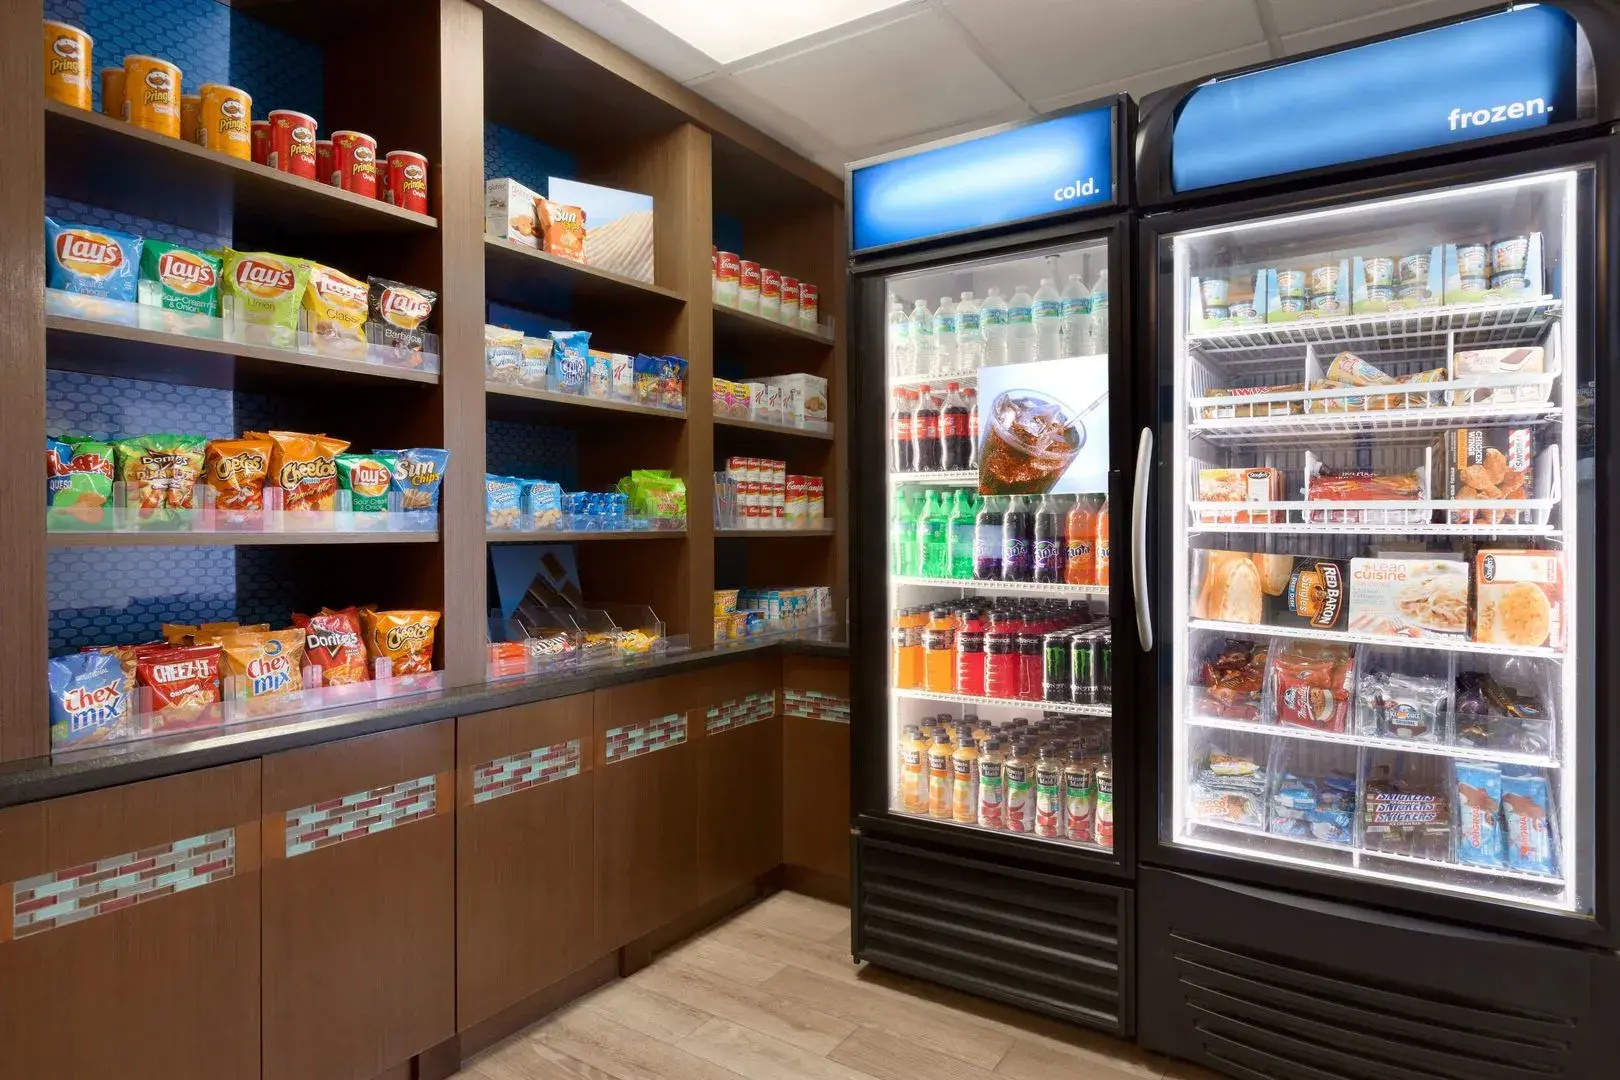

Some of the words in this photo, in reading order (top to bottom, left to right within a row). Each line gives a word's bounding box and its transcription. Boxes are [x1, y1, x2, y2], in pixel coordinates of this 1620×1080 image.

[1447, 96, 1554, 131] frozen.
[1053, 178, 1100, 203] cold.
[554, 206, 577, 223] Sun
[62, 235, 118, 264] Lay's
[162, 255, 211, 283] Lay's
[240, 261, 292, 288] Lay's
[176, 301, 200, 313] Onion
[383, 288, 431, 318] Lay's
[385, 328, 422, 345] Barbecue
[1475, 430, 1483, 464] CHICKEN
[279, 458, 336, 489] Cheetos
[354, 467, 388, 487] Lay's
[394, 460, 435, 481] Sun
[411, 472, 439, 487] Chips
[50, 480, 73, 490] QUESO
[1005, 544, 1027, 557] anta
[1036, 545, 1058, 559] anta
[1323, 566, 1338, 588] RED
[1373, 561, 1407, 572] Lean
[1299, 575, 1312, 612] Singles
[1318, 588, 1339, 625] BARON
[307, 632, 358, 649] Doritos
[153, 659, 210, 684] CHEEZ-IT
[246, 655, 290, 679] Chex
[64, 679, 122, 714] Chex
[253, 672, 291, 697] mix
[71, 697, 124, 732] mix
[1375, 812, 1437, 822] SNICKERS
